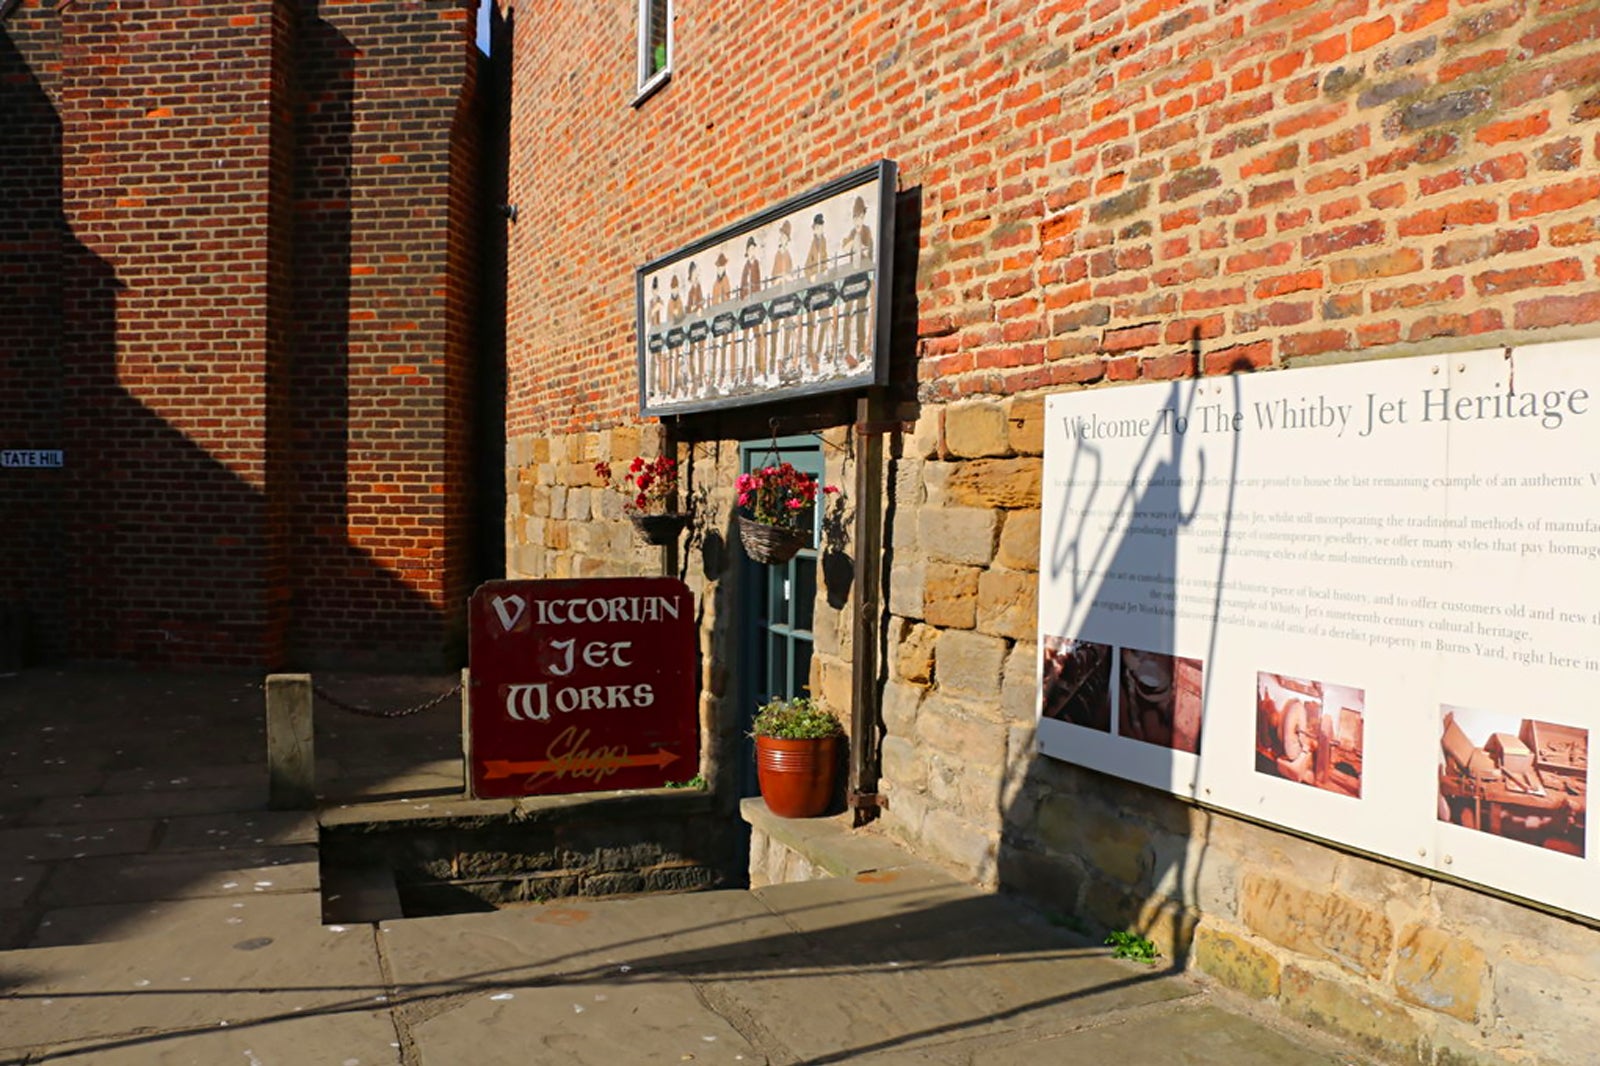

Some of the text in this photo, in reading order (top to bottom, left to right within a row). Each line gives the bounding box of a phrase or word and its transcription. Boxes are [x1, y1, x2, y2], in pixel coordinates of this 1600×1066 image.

[1063, 382, 1589, 440] Welcome To The Whitby Jet Heritage
[4, 452, 36, 465] TATE
[1334, 474, 1351, 488] the
[1373, 475, 1429, 492] remaining
[1432, 473, 1482, 491] example
[1486, 473, 1500, 487] of
[1502, 477, 1518, 487] an
[1521, 472, 1583, 487] authentic
[1387, 513, 1404, 527] the
[1407, 514, 1467, 529] traditional
[1471, 515, 1523, 531] methods
[1528, 516, 1542, 531] of
[1422, 537, 1453, 553] many
[1457, 536, 1489, 555] styles
[1493, 538, 1517, 553] that
[1521, 542, 1544, 559] pay
[492, 594, 680, 631] VICTORIAN
[1373, 592, 1394, 606] and
[1397, 595, 1409, 607] to
[1411, 595, 1437, 610] offer
[1441, 600, 1501, 616] customers
[1504, 602, 1525, 618] old
[1529, 606, 1555, 621] and
[1560, 611, 1587, 623] new
[1428, 617, 1475, 635] cultural
[548, 637, 633, 676] JET
[1420, 639, 1433, 650] in
[1435, 638, 1471, 654] Burns
[1513, 649, 1544, 667] right
[1549, 651, 1580, 668] here
[1586, 658, 1598, 671] in
[506, 683, 655, 721] WORKS
[524, 726, 632, 790] Shop
